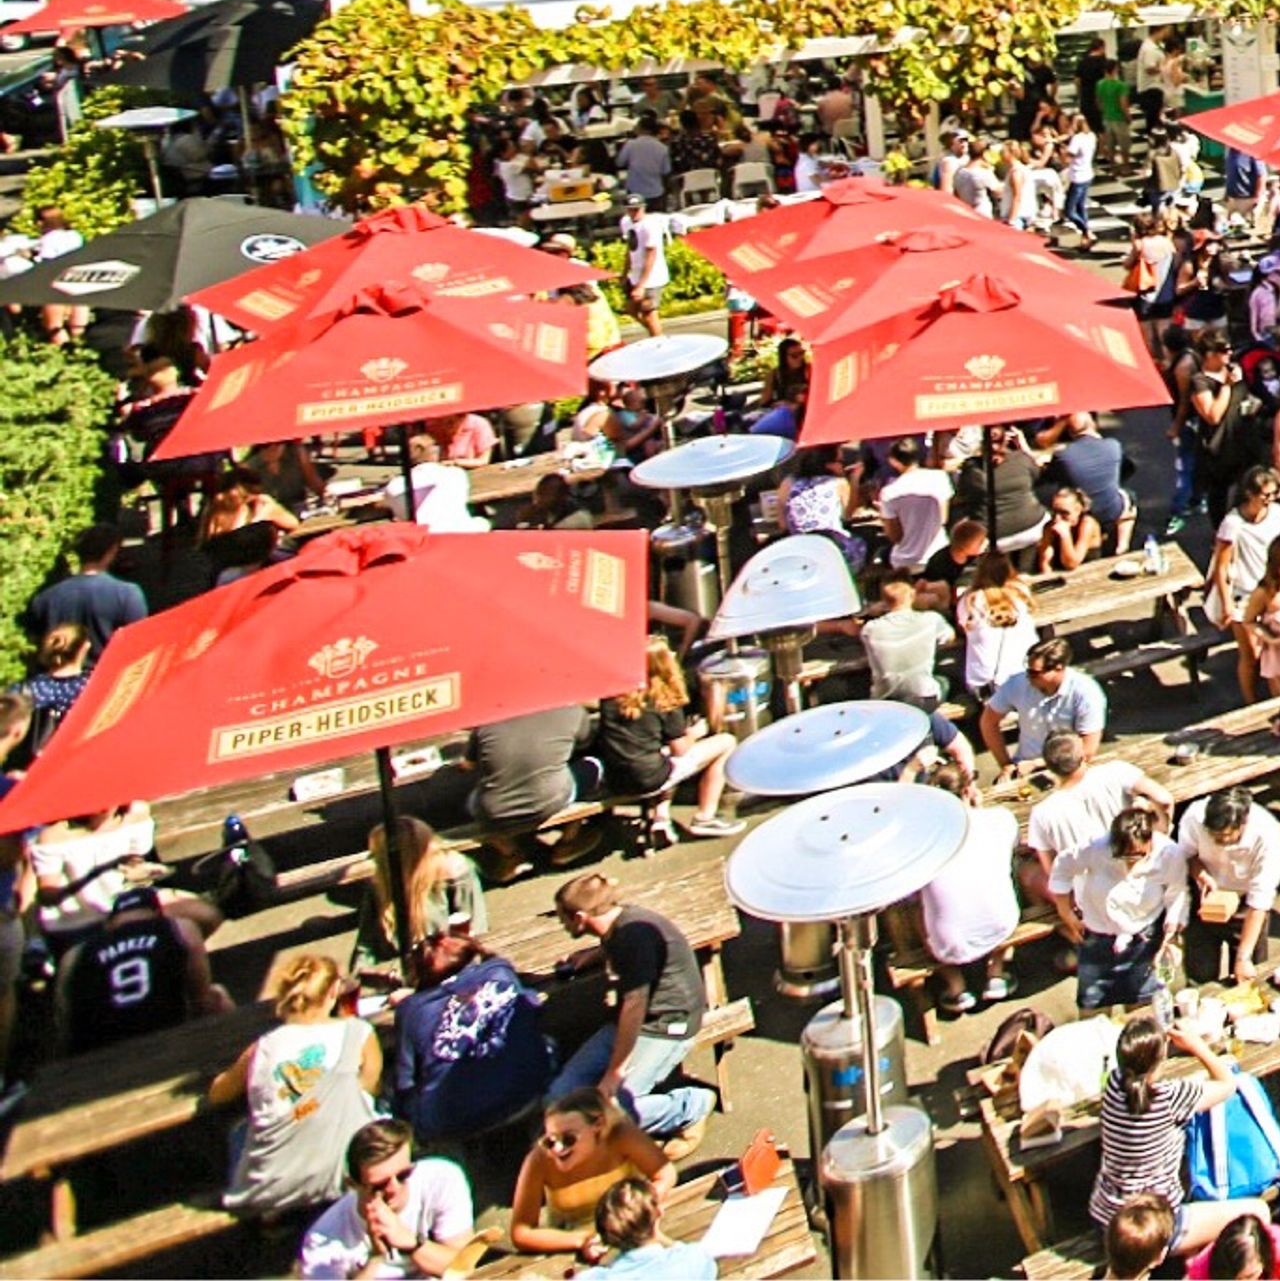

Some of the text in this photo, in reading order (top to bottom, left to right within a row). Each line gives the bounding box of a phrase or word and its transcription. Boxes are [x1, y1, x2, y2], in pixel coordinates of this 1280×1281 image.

[320, 375, 442, 401] CHAMPAGNE
[249, 662, 429, 717] CHAMPAGNE
[230, 686, 441, 751] PIPER-HEIDSIECK
[112, 957, 150, 1004] 9
